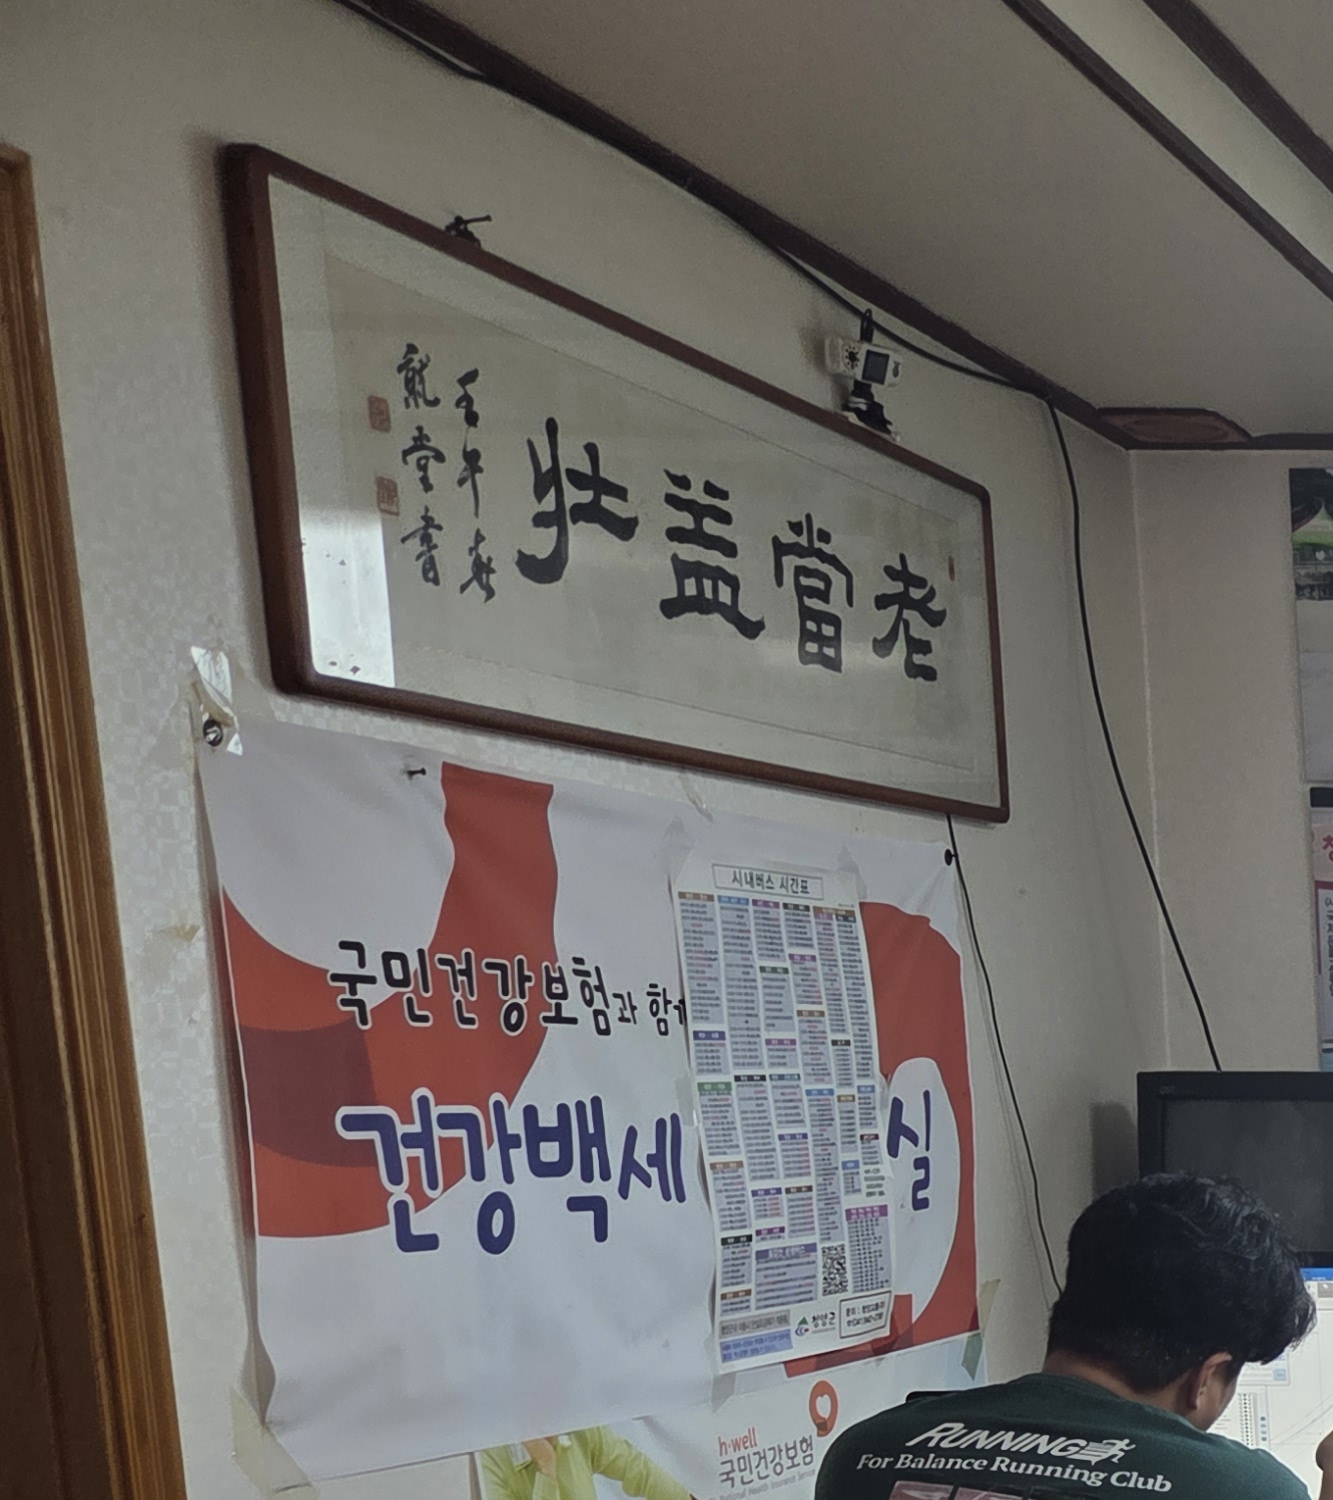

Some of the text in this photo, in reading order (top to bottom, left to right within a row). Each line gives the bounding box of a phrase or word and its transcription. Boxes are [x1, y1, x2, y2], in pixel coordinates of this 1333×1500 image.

[731, 868, 811, 895] 시내버스 시간표
[330, 942, 639, 1036] 국민건강보험과
[718, 1434, 815, 1489] 국민건강보험
[856, 1454, 1172, 1493] For Balance Running Club
